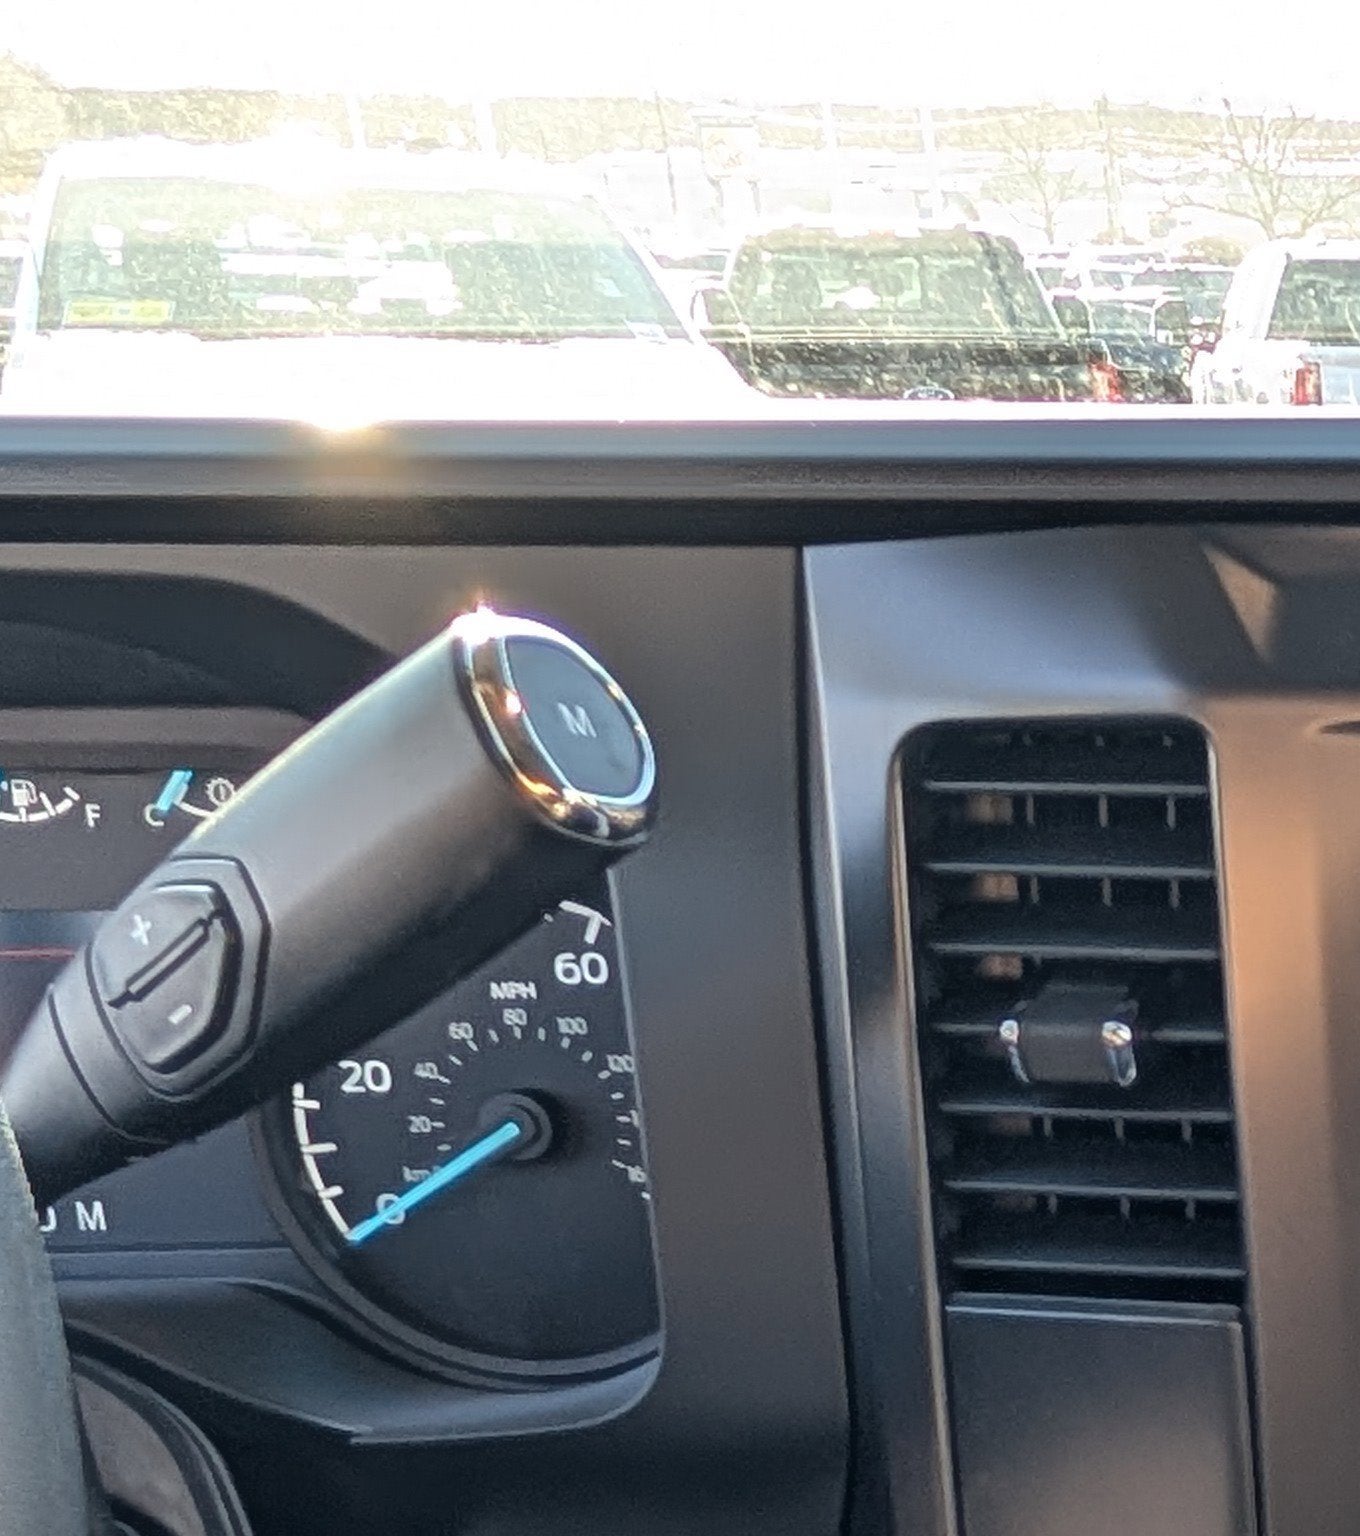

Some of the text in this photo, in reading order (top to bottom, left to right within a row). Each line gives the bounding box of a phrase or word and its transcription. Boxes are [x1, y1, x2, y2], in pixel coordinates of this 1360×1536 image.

[557, 702, 597, 738] M
[85, 804, 100, 827] F
[554, 953, 608, 984] 60
[490, 981, 538, 1000] MPH
[557, 1017, 588, 1036] 100
[338, 1060, 392, 1093] 20
[75, 1200, 107, 1231] M
